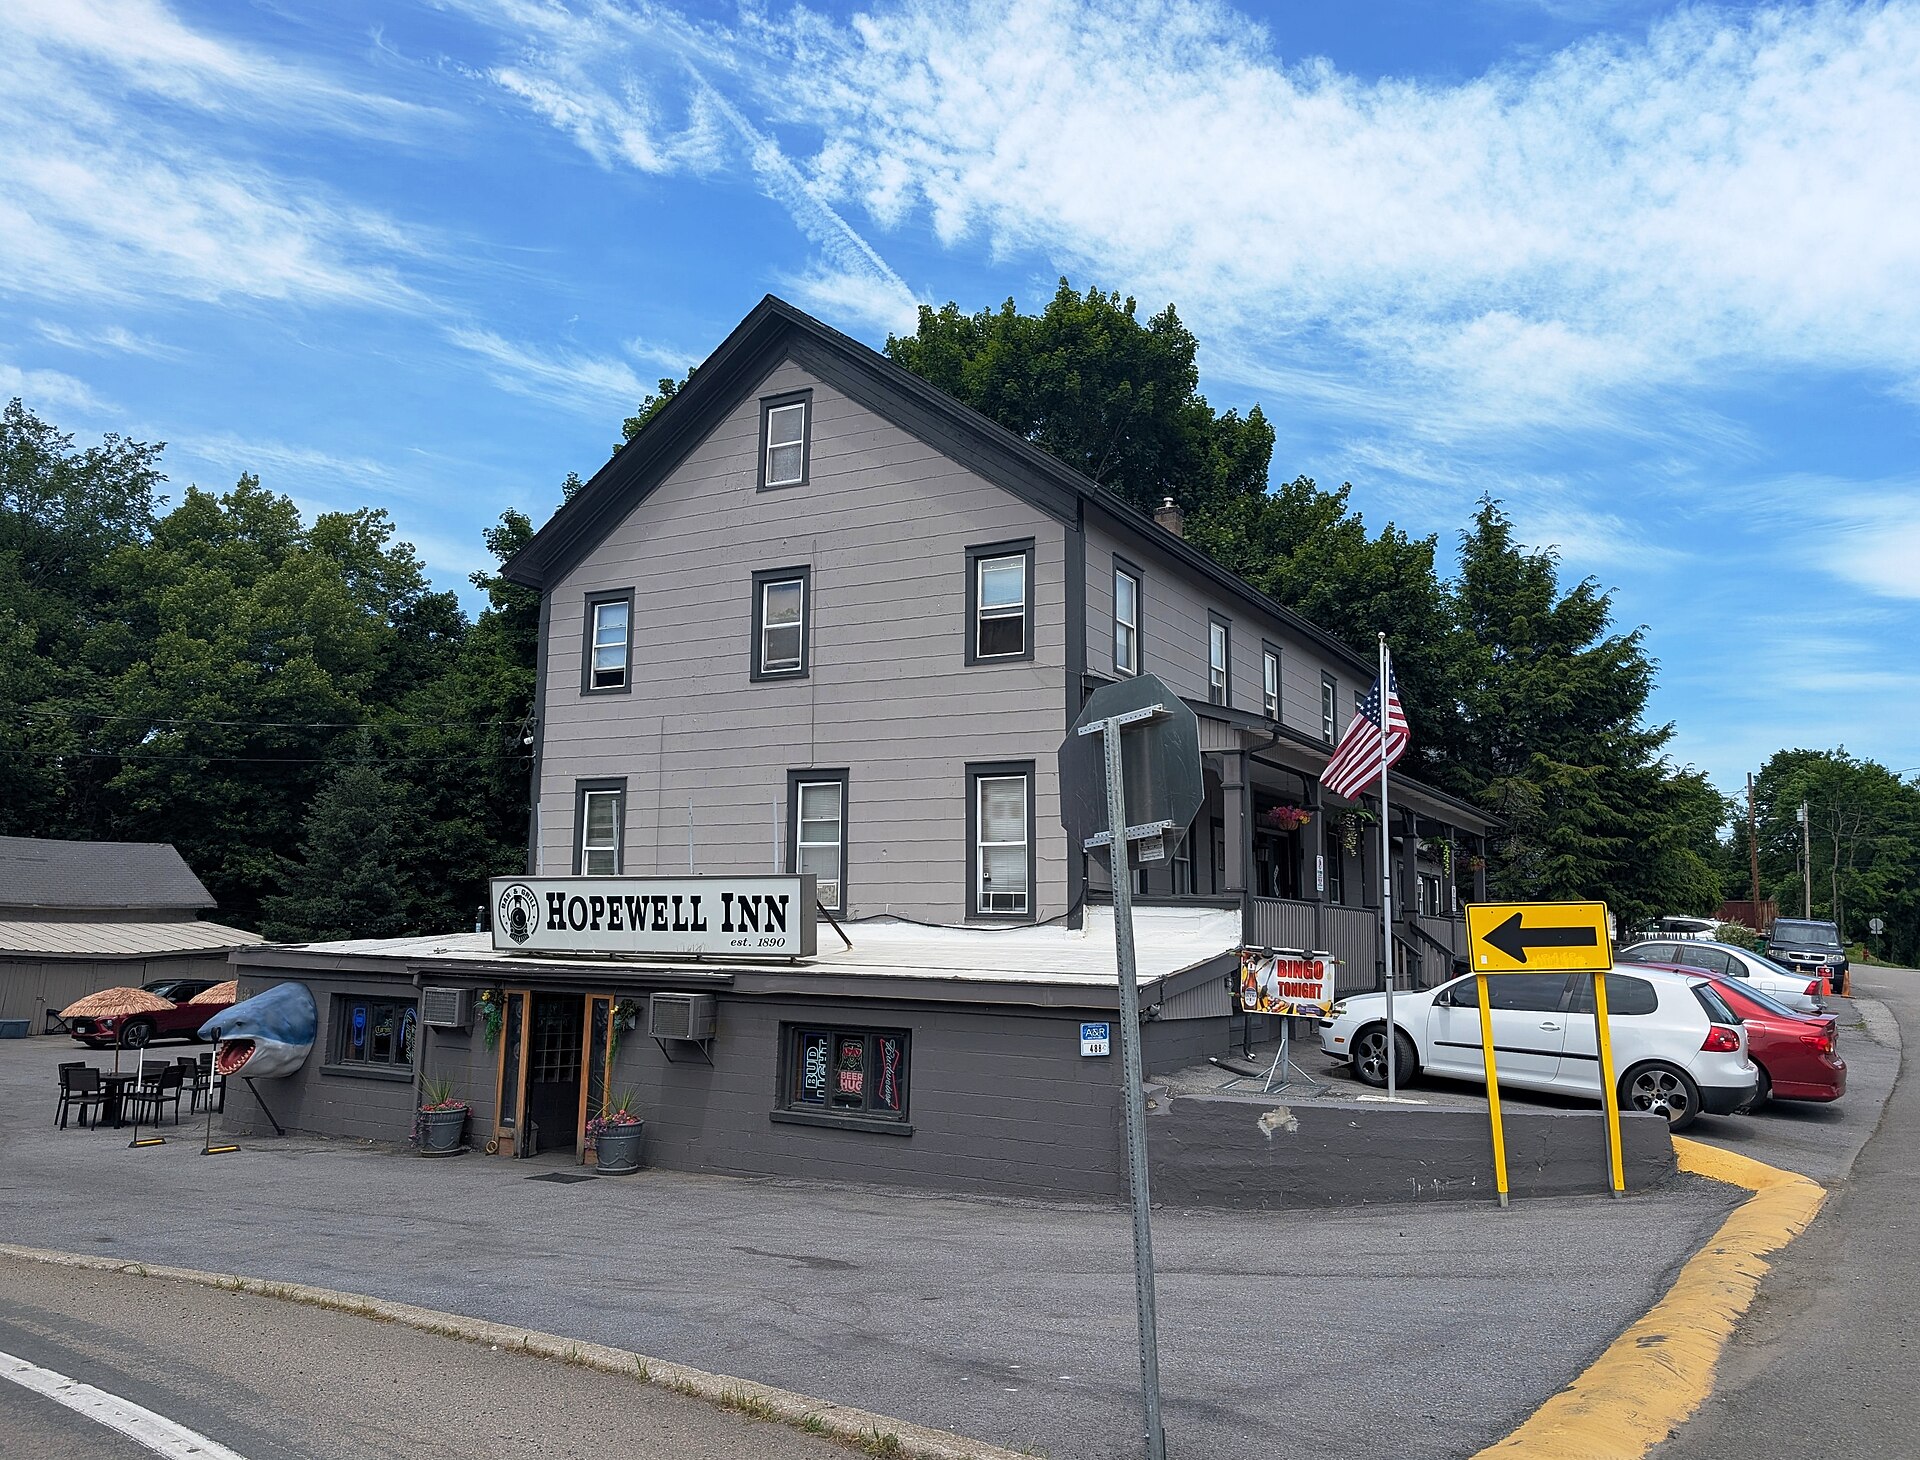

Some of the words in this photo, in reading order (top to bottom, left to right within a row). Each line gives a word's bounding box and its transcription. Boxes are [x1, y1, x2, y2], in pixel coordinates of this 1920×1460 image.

[501, 892, 511, 909] BAR
[521, 888, 536, 910] GRILL
[546, 892, 707, 931] HOPEWELL
[721, 893, 790, 933] INN
[730, 938, 752, 947] est.
[757, 937, 786, 948] 1890
[1276, 959, 1324, 980] BINGO
[1277, 981, 1323, 1000] TONIGHT
[1085, 1028, 1106, 1037] A&R
[805, 1046, 819, 1089] BUD
[840, 1072, 863, 1080] BEER
[885, 1039, 896, 1106] Budweiser
[840, 1080, 863, 1092] HUG
